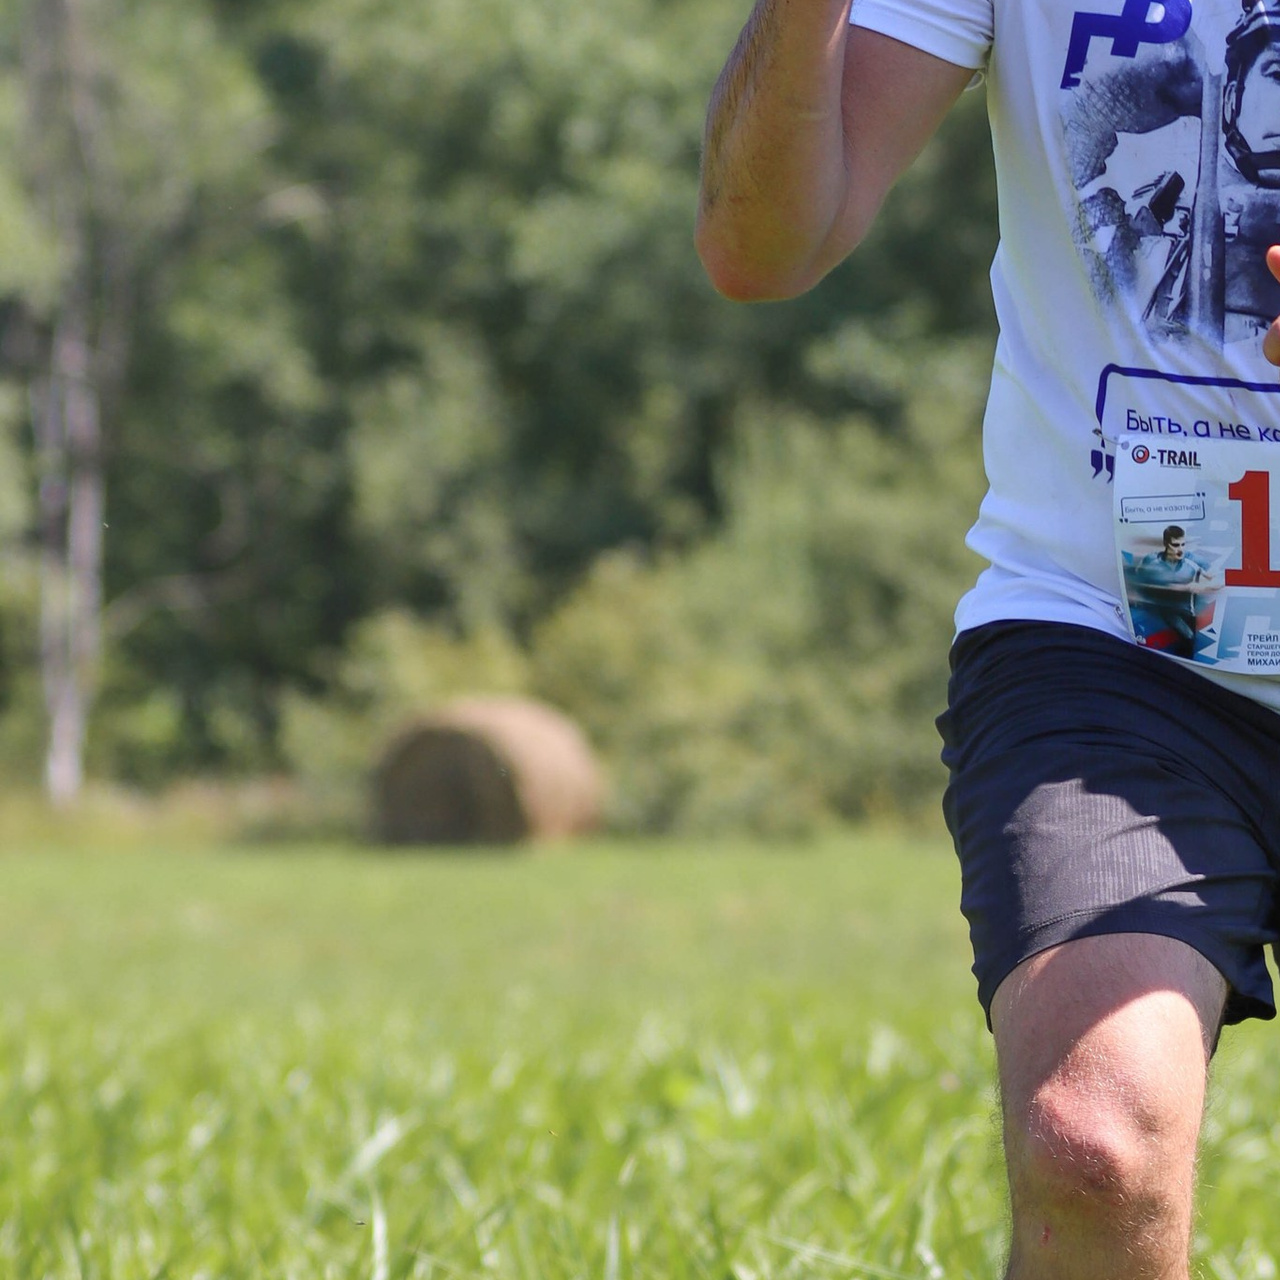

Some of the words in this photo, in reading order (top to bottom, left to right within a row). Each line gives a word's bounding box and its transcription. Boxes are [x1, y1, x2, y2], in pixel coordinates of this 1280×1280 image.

[1126, 409, 1188, 437] Быть,
[1193, 420, 1211, 438] а
[1219, 421, 1251, 439] не
[1247, 633, 1279, 643] ТРЕЙЛ
